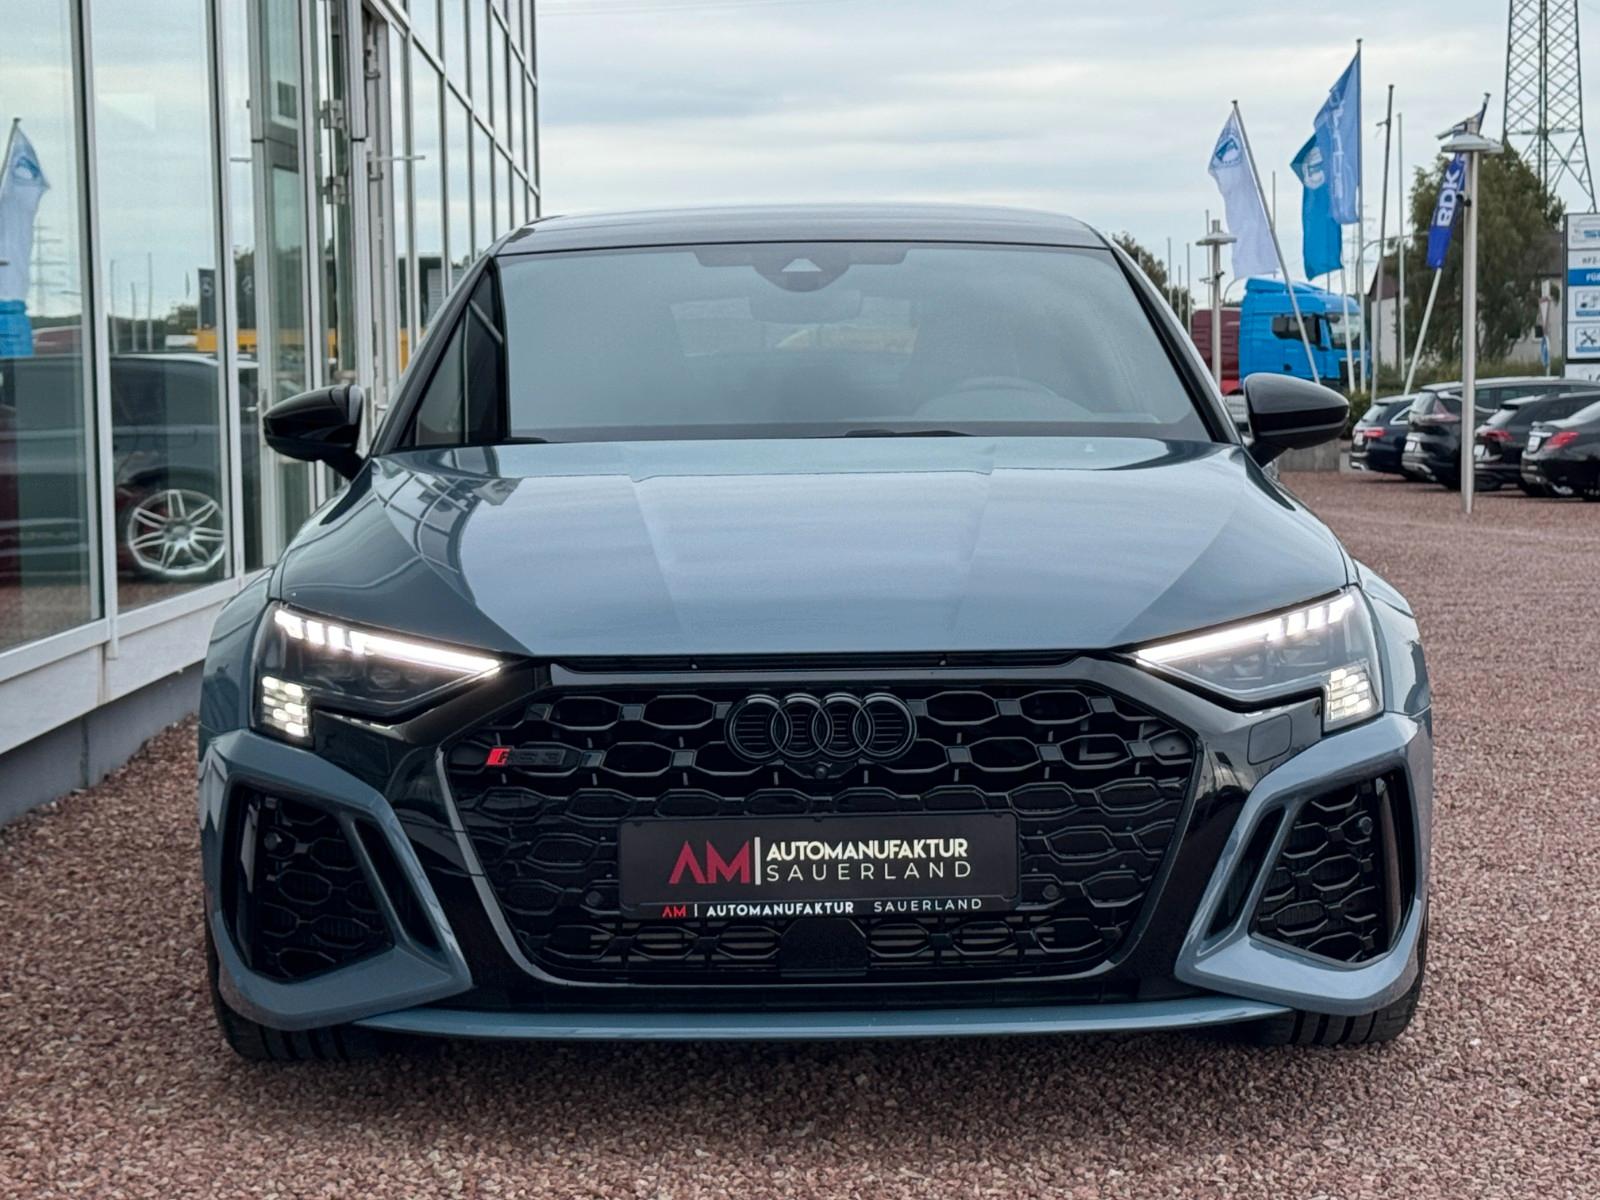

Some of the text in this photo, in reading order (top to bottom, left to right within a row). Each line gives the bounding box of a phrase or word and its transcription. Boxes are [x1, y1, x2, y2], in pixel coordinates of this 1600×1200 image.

[1437, 169, 1460, 226] BDK
[766, 839, 968, 861] AUTOMANUFAKTUR
[669, 840, 751, 884] AM
[766, 861, 972, 881] SAUERLAND
[662, 898, 982, 918] AM AUTOMANUFAKTUR SAUERLAND
